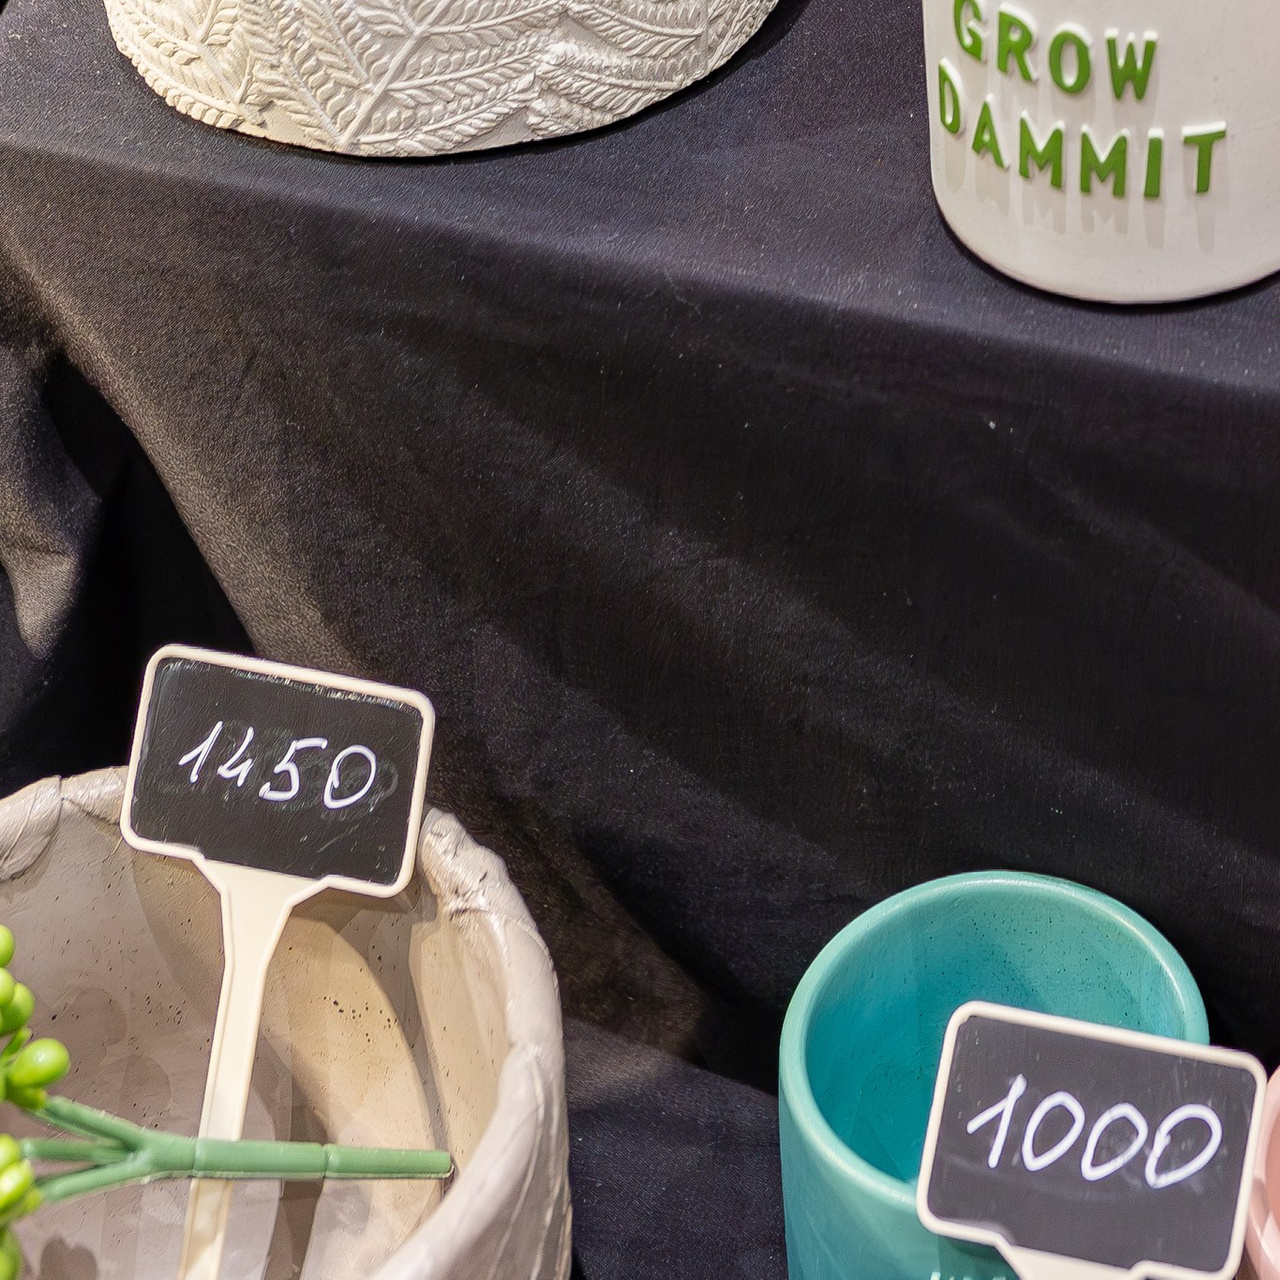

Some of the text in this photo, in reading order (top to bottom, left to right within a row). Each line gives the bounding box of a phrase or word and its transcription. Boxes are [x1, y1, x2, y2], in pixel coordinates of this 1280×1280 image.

[938, 57, 1227, 199] DAMMIT
[179, 720, 376, 809] 1450
[966, 1074, 1222, 1189] 1000
